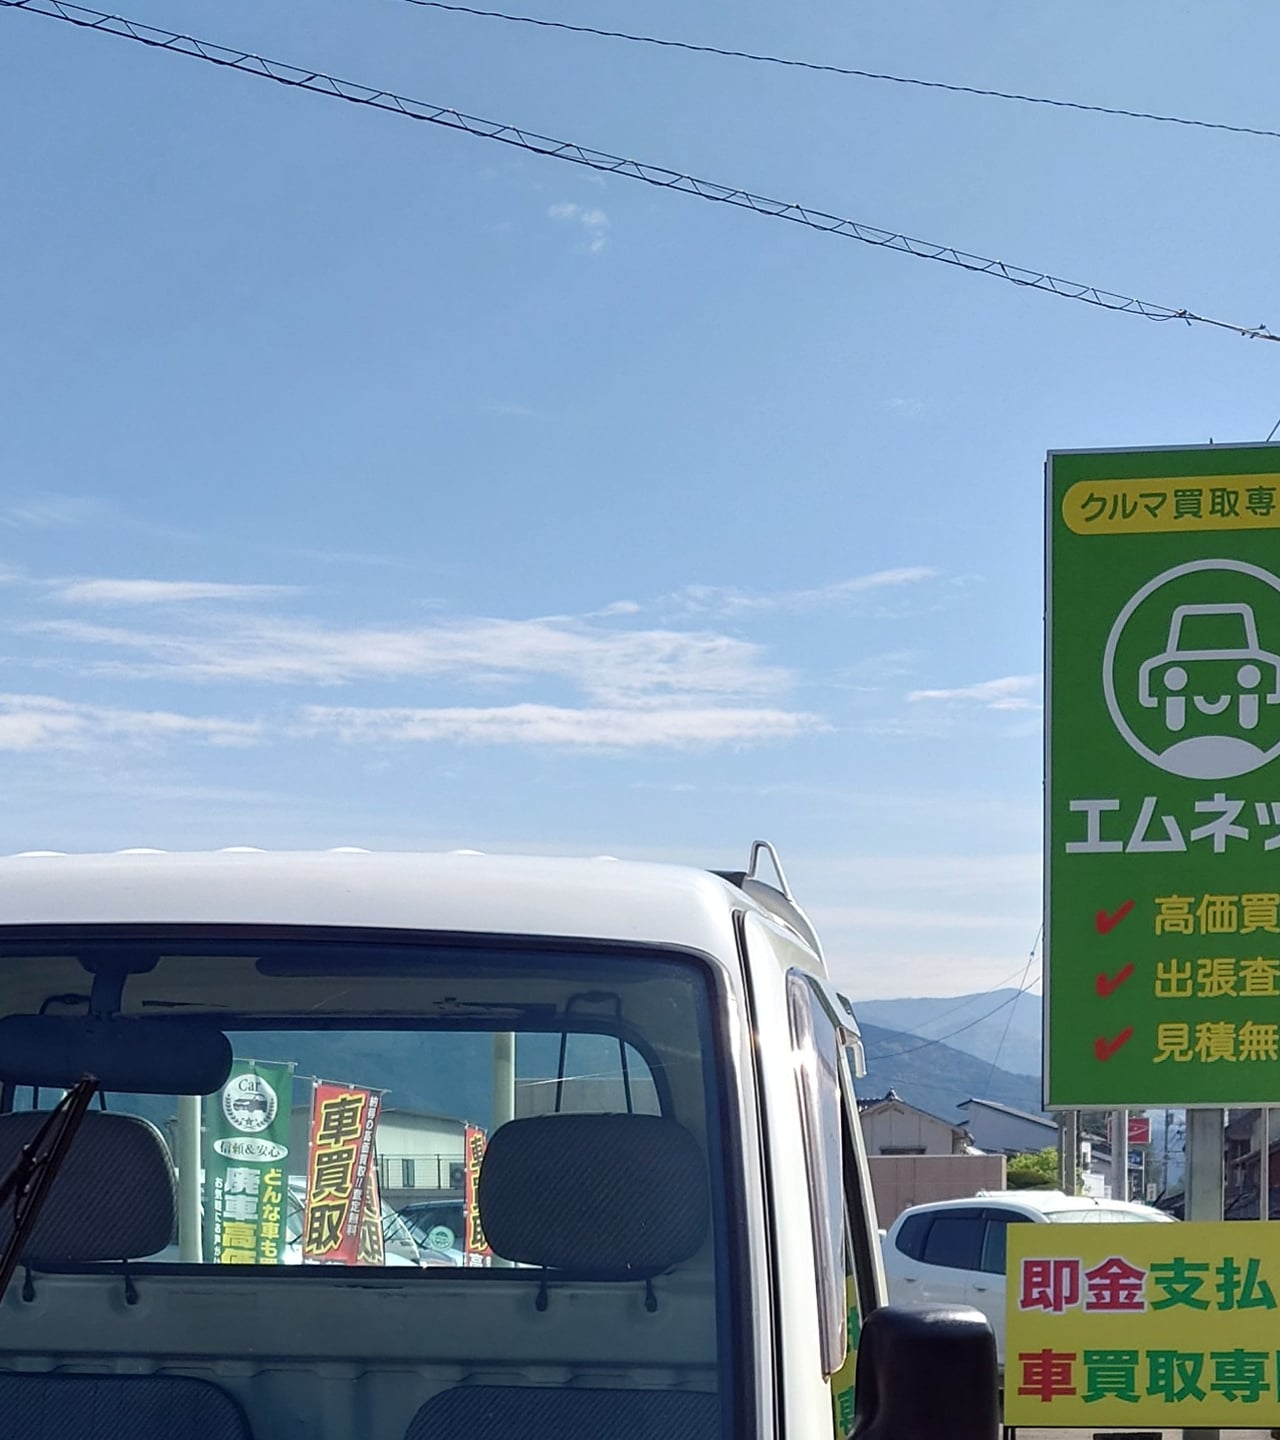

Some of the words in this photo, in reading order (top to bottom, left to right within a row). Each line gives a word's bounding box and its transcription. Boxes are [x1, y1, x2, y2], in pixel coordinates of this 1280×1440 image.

[238, 1078, 261, 1092] Car
[305, 1094, 365, 1254] 車買取
[470, 1133, 489, 1251] 車取
